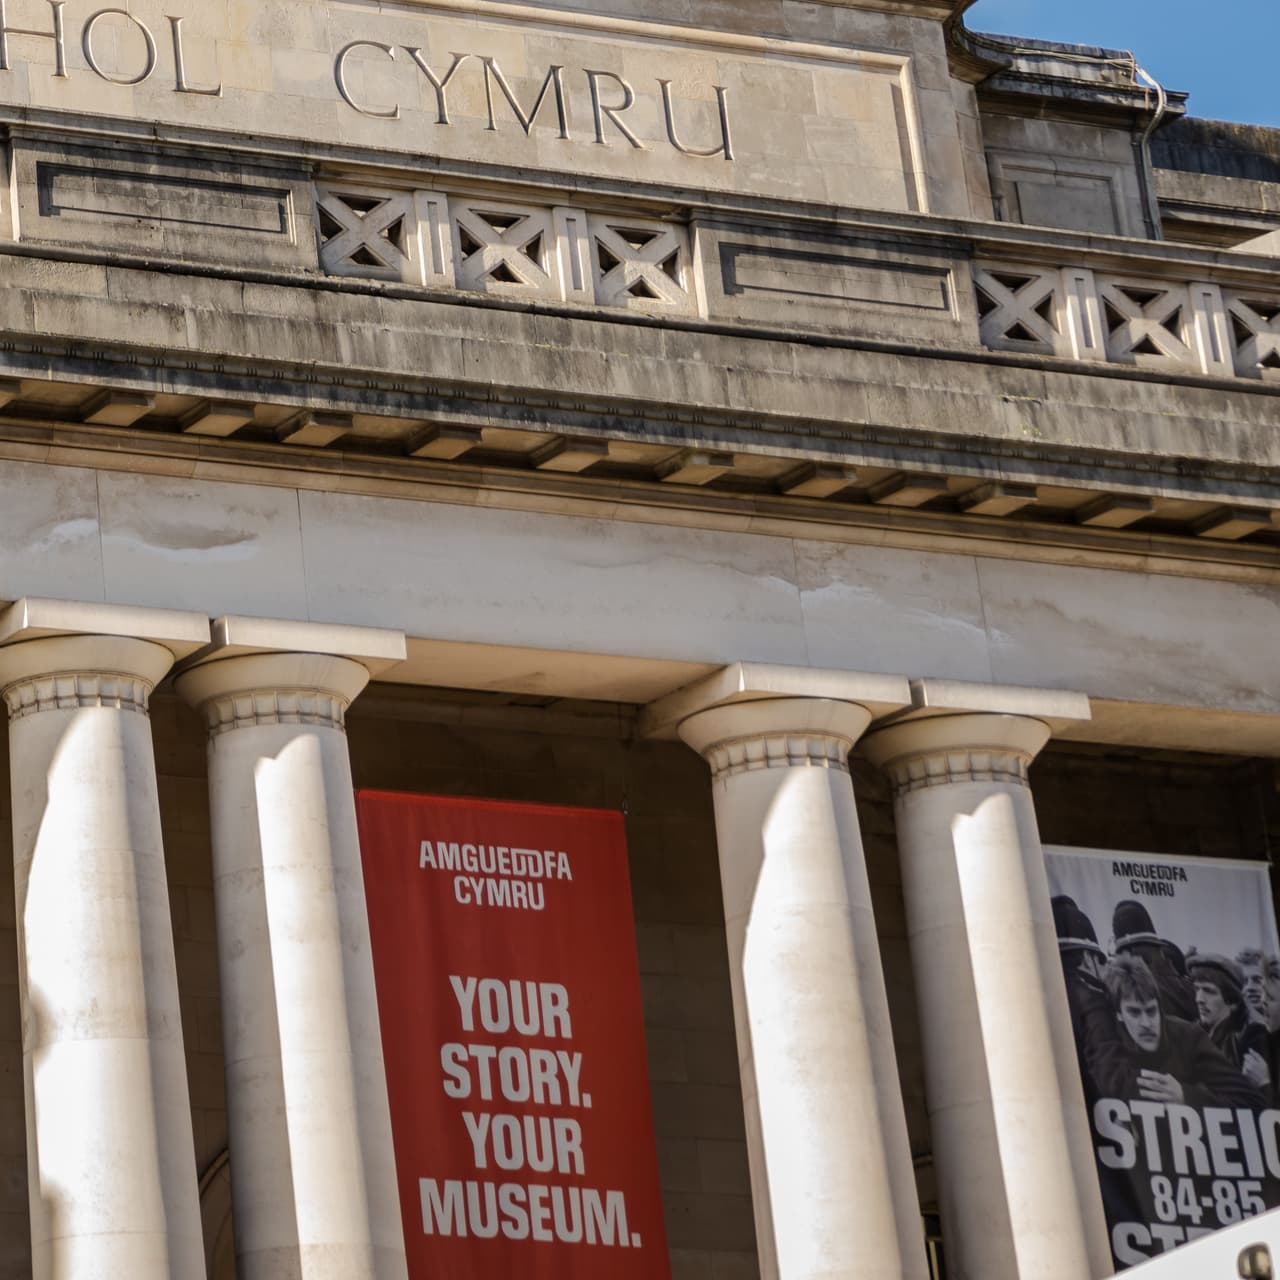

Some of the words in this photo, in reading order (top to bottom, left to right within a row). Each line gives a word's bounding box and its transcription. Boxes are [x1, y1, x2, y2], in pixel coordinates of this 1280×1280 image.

[334, 40, 735, 161] CYMRU
[419, 840, 573, 881] AMGUEDDFA
[1112, 862, 1188, 882] AMGUEDDFA
[1130, 879, 1175, 897] CYMRU
[454, 875, 545, 910] CYMRU
[449, 975, 573, 1039] YOUR
[440, 1043, 592, 1109] STORY.
[461, 1111, 586, 1175] YOUR
[419, 1177, 642, 1248] MUSEUM.
[1150, 1175, 1266, 1225] 84-85
